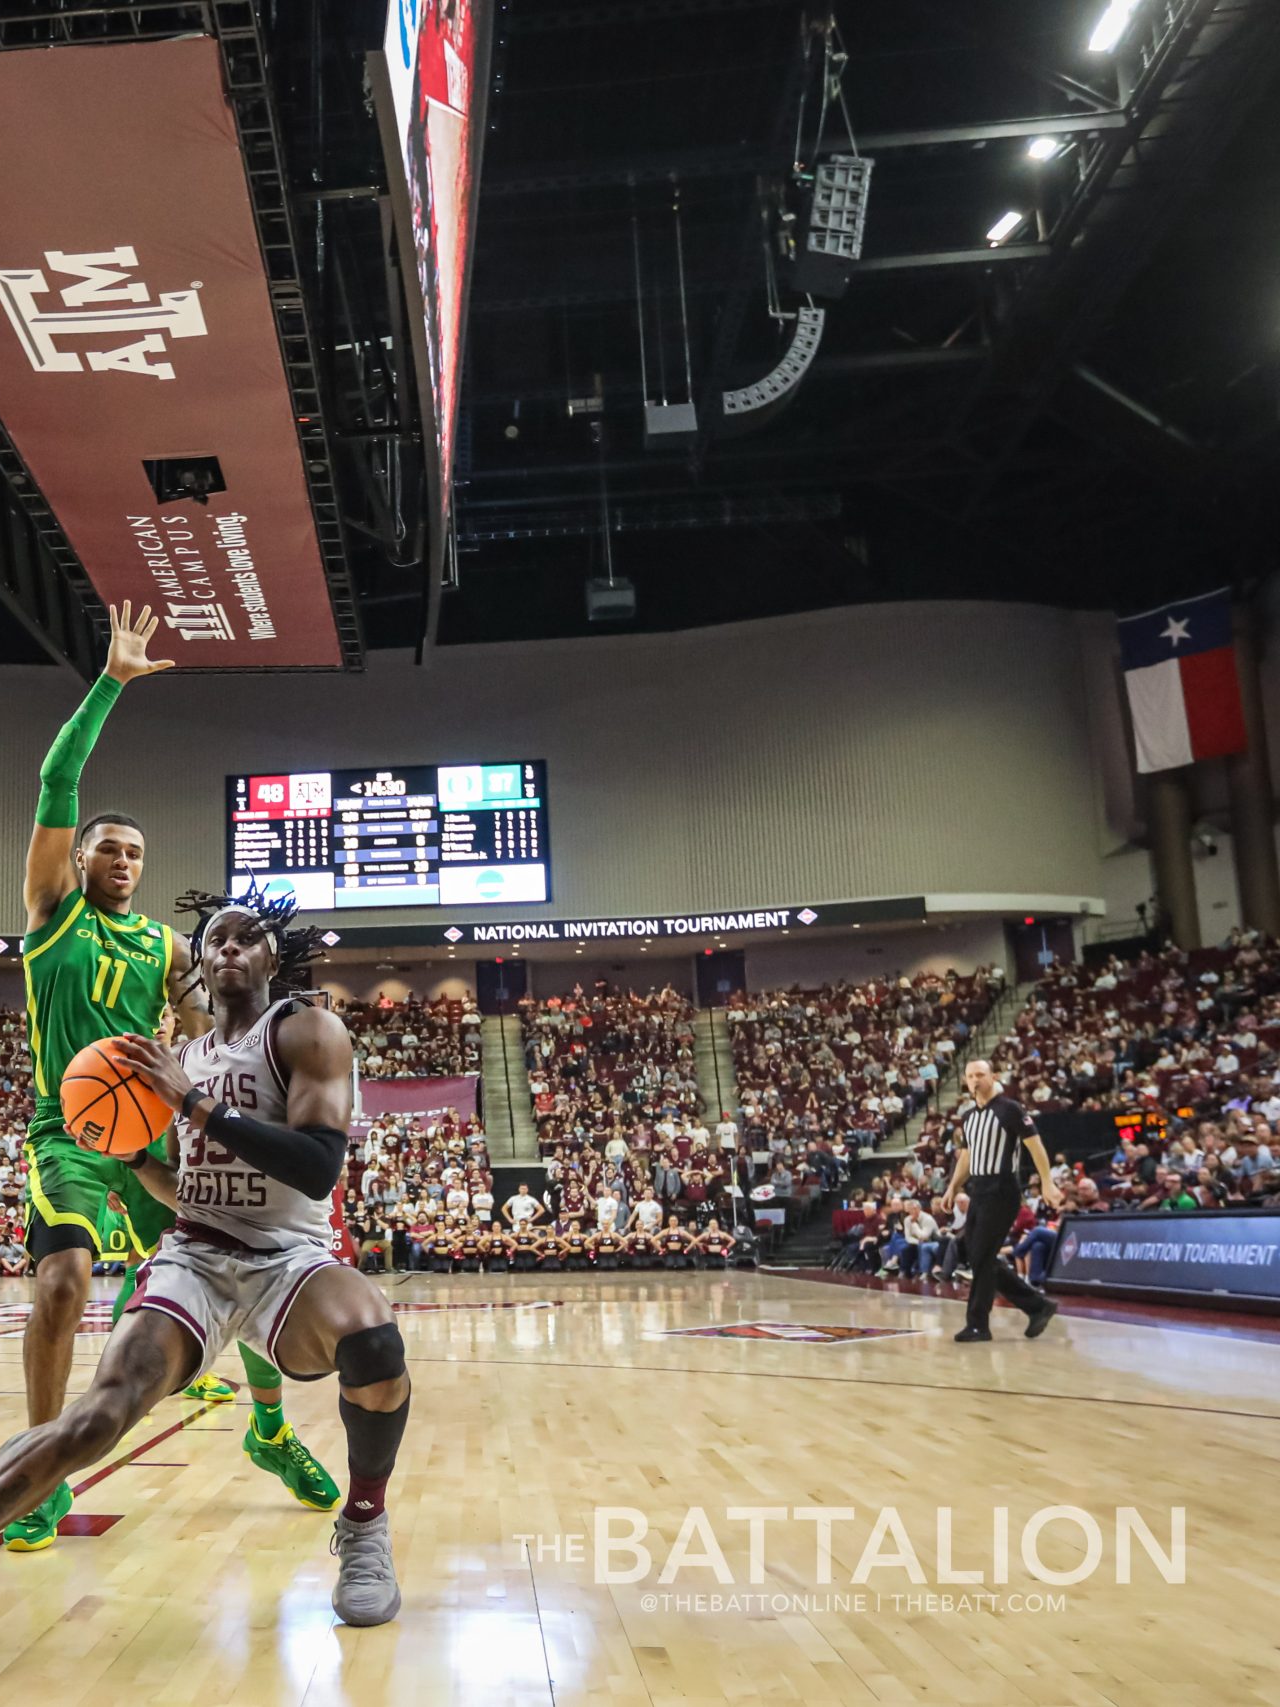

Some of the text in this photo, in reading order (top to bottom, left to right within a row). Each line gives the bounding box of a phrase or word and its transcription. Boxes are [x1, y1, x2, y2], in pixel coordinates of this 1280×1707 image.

[126, 515, 187, 599] AMERICAN
[161, 516, 216, 599] CAMPUS
[213, 512, 277, 640] Where students love living.
[257, 784, 284, 803] 48
[473, 910, 790, 941] NATIONAL INVITATION TOURNAMENT
[91, 954, 128, 1009] 11
[1077, 1241, 1278, 1266] NATIONAL INVITATION TOURNAMENT
